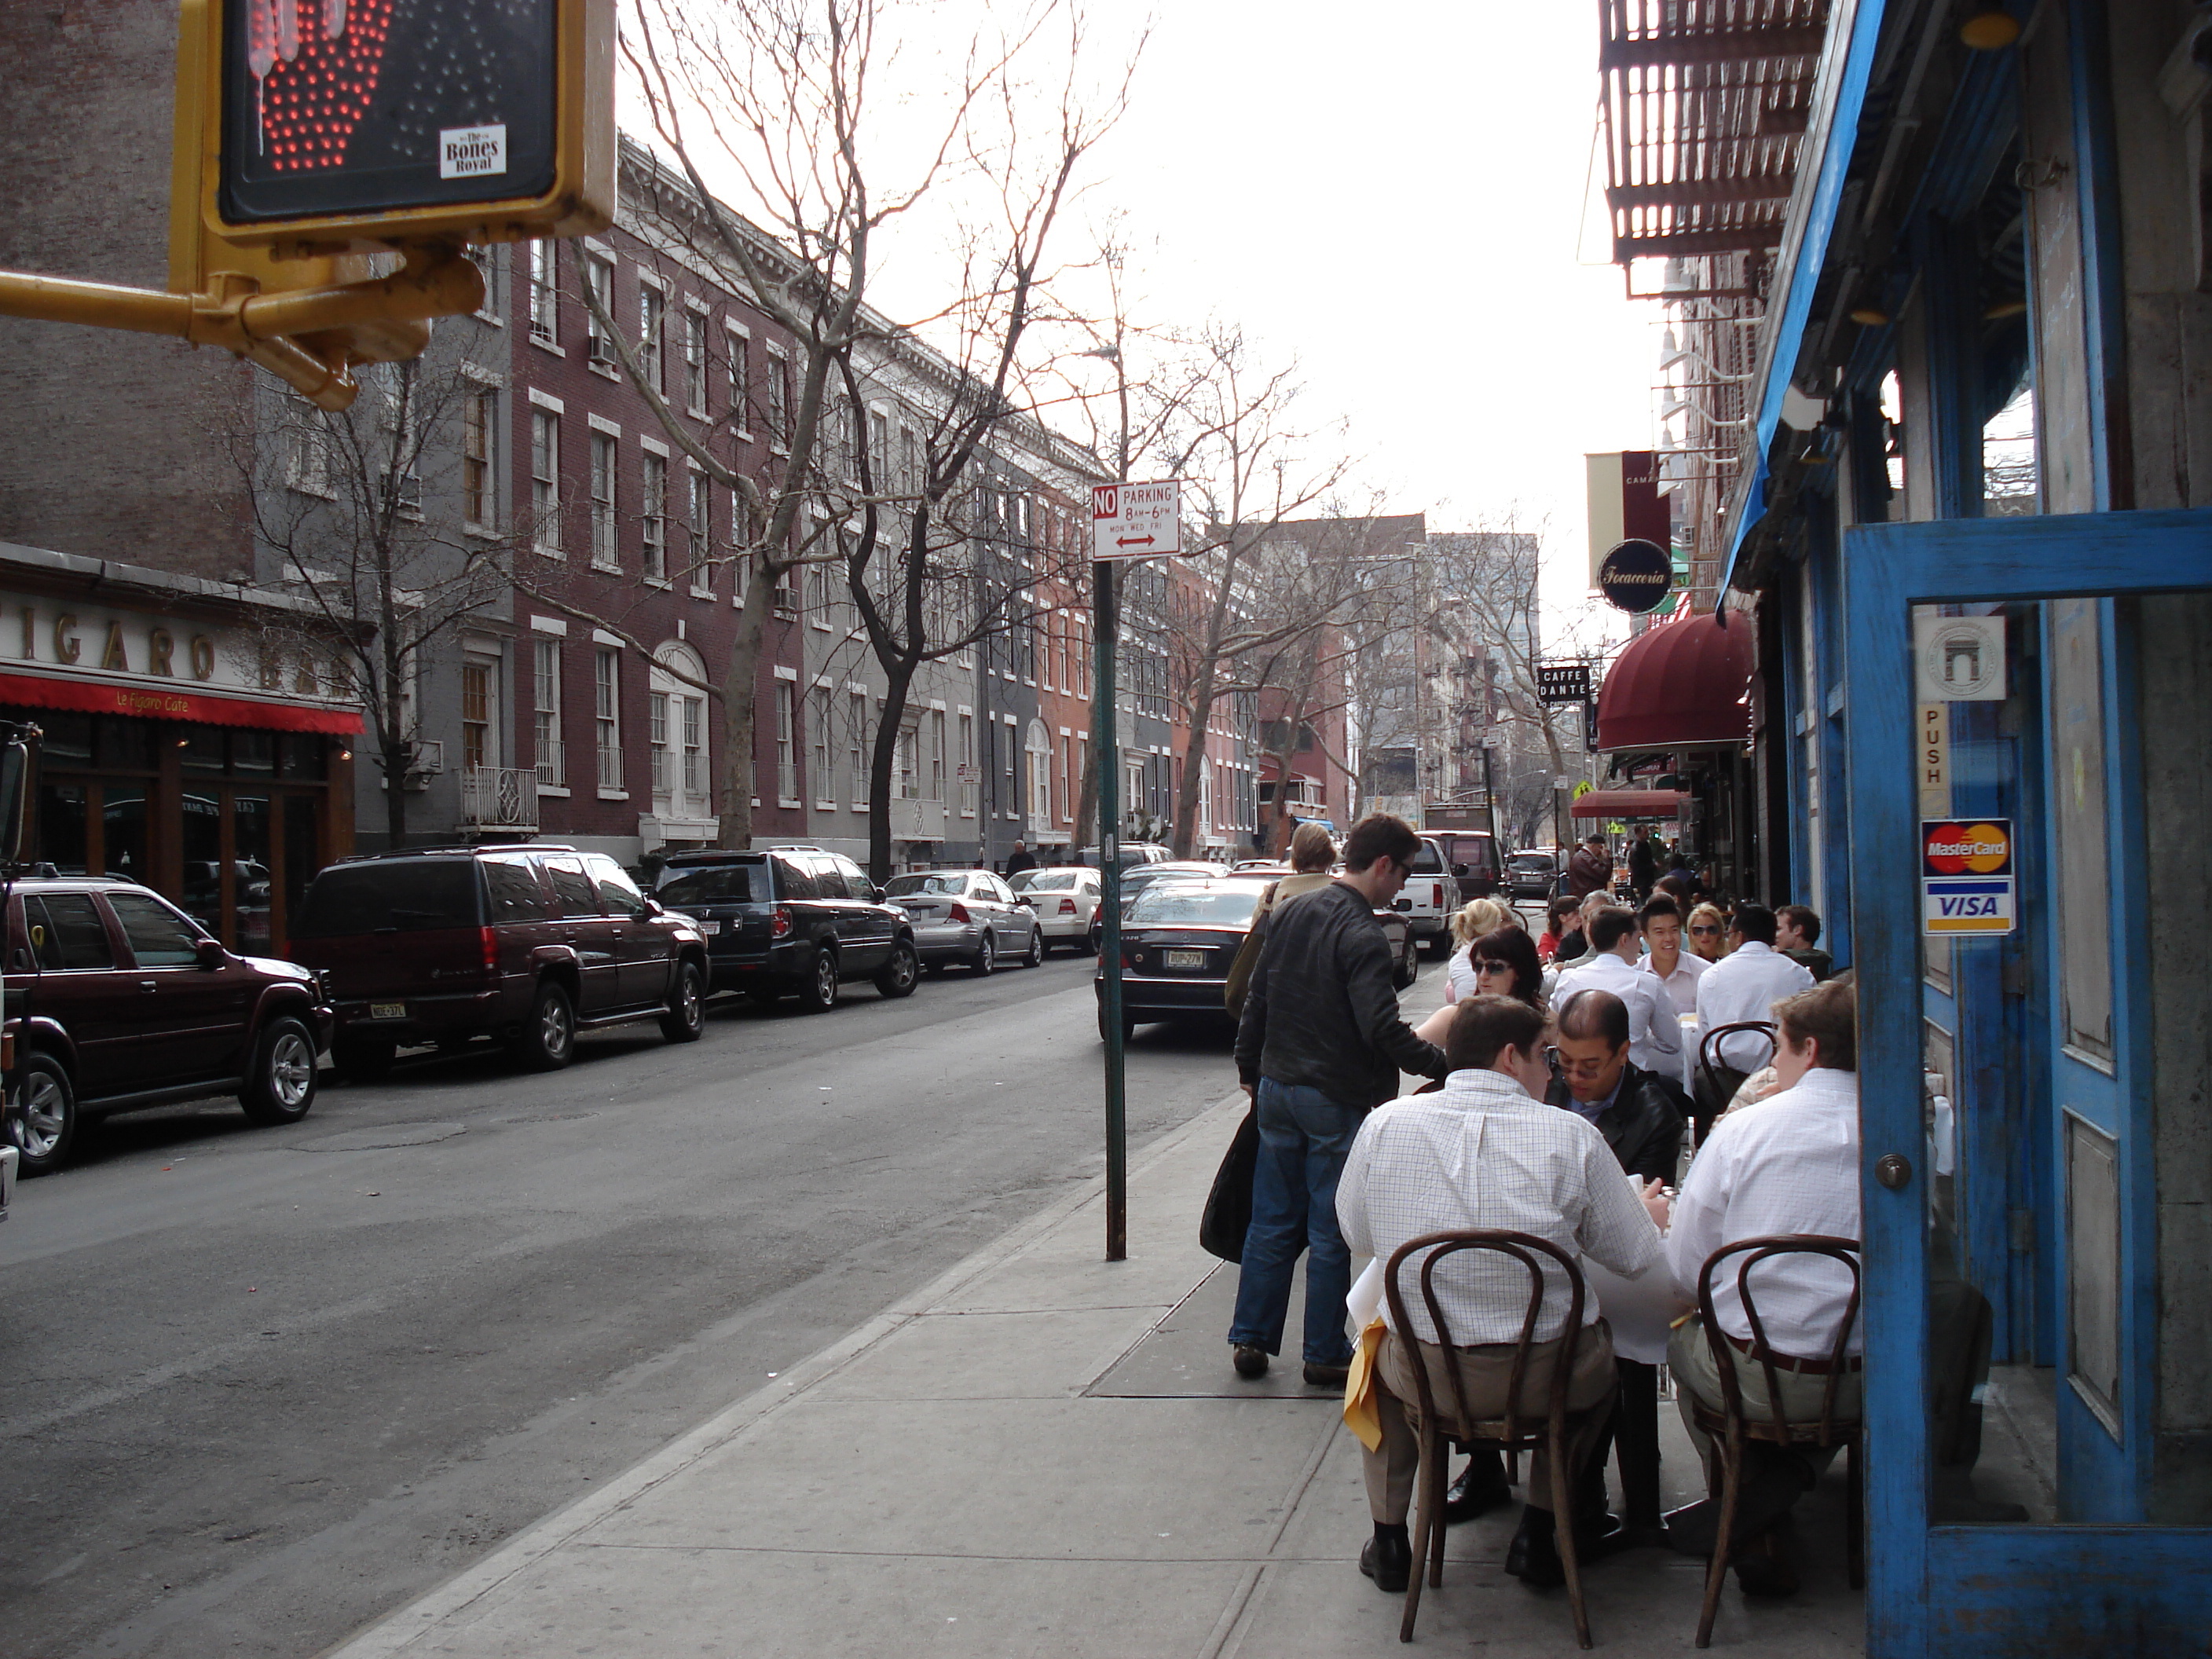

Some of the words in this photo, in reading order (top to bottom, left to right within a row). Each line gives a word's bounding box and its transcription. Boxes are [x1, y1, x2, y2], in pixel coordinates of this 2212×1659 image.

[467, 132, 481, 143] The
[446, 140, 499, 161] Bones
[456, 157, 492, 172] Royal
[1094, 489, 1116, 515] NO
[1123, 487, 1171, 504] PARKING
[1126, 506, 1170, 521] 8AM-6PM
[1110, 525, 1125, 533] MON
[1130, 523, 1144, 532] WED
[1150, 522, 1162, 530] FRI
[1603, 566, 1664, 584] Focacceria
[0, 605, 215, 682] IGARO
[1544, 671, 1581, 682] CAFFE
[1540, 685, 1585, 696] DANTE
[117, 691, 127, 706] Le
[130, 693, 162, 712] Figaro
[1927, 711, 1940, 783] PUSH
[1928, 841, 2006, 856] MasterCard
[1938, 897, 1999, 916] VISA
